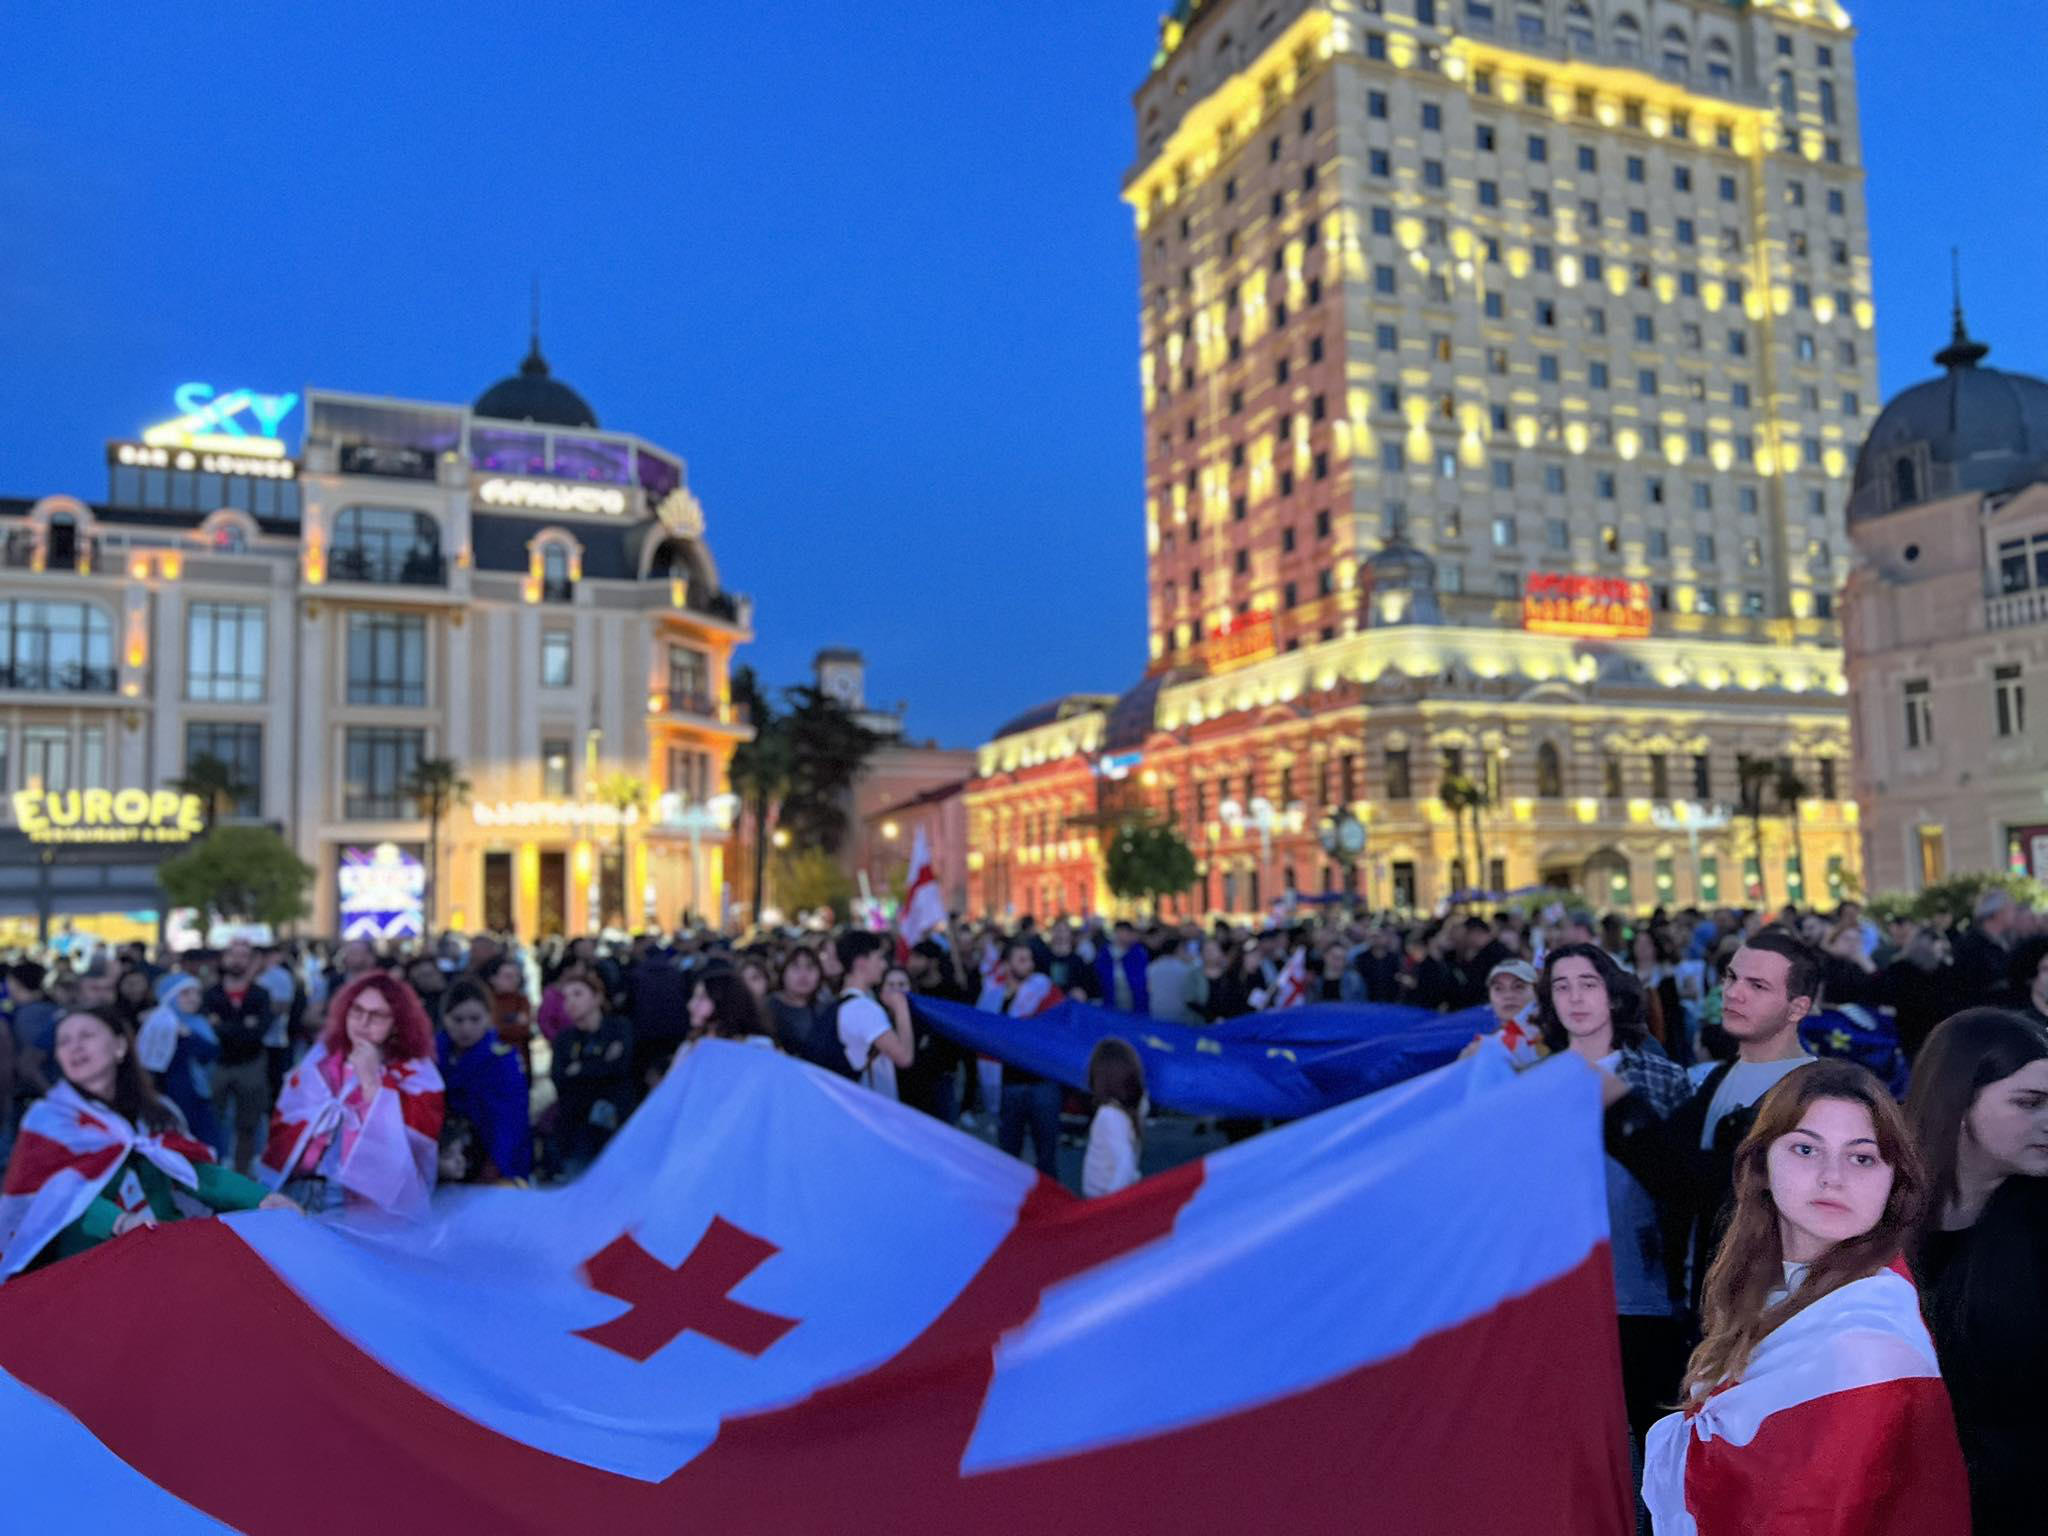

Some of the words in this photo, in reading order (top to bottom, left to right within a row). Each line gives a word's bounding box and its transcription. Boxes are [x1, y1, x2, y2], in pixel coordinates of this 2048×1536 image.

[173, 382, 299, 439] SKY
[118, 444, 169, 468] BAR
[202, 453, 296, 480] LOUNGE
[13, 786, 205, 833] EUROPE
